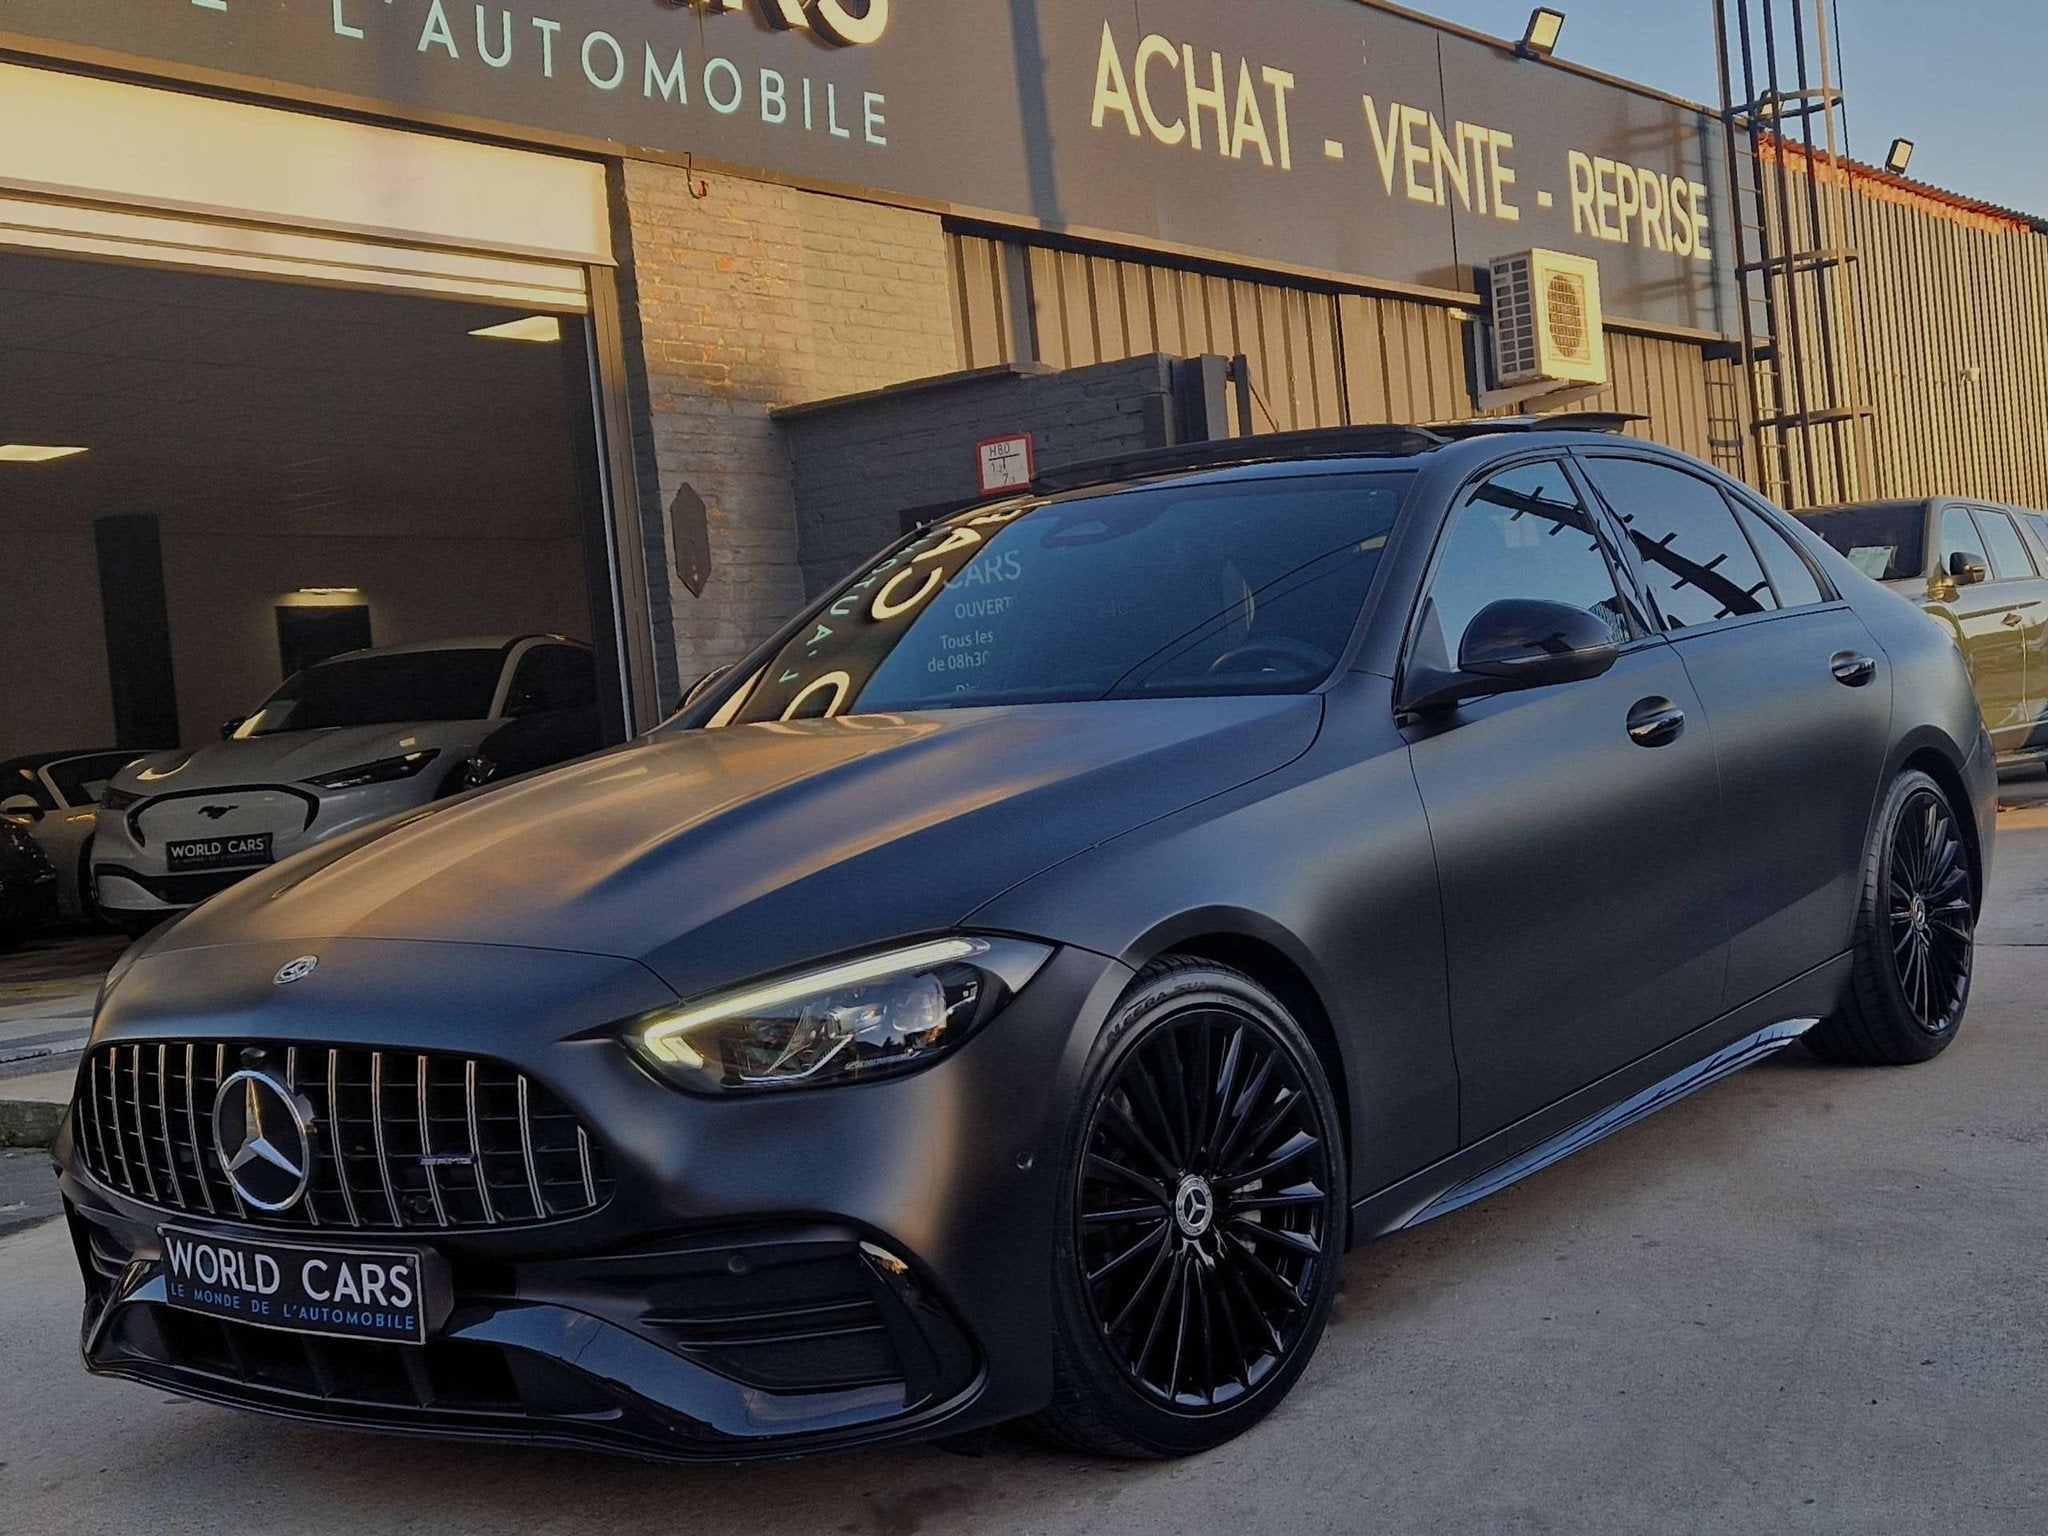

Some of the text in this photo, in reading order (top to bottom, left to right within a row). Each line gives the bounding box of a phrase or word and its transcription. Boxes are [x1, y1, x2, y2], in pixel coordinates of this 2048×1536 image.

[332, 0, 888, 146] LAUTOMOBILE
[1092, 19, 1293, 169] ACHAT
[1363, 95, 1519, 220] VENTE
[1567, 150, 1712, 260] REPRISE
[955, 596, 1013, 620] OUVERT
[940, 629, 994, 651] Tous les
[928, 658, 946, 673] de
[171, 842, 221, 858] WORLD
[228, 838, 264, 853] CARS
[165, 1237, 413, 1308] WORLD CARS
[170, 1283, 415, 1331] LE MONDE DE L'AUTOMOBILE
